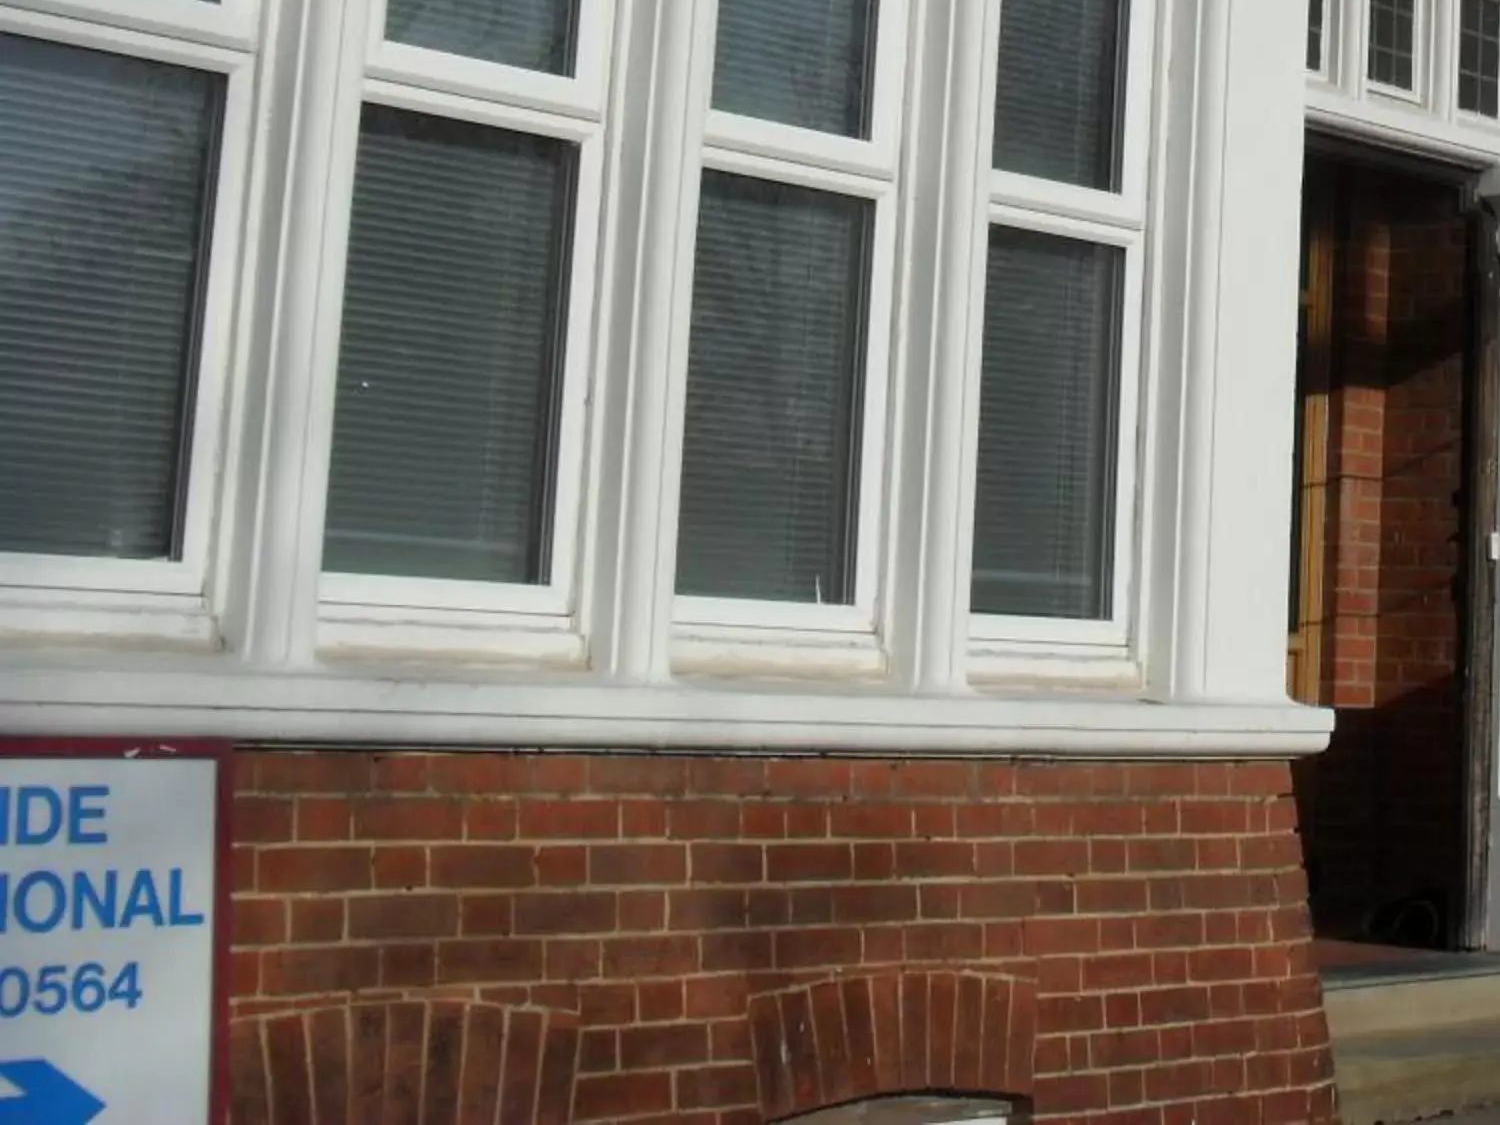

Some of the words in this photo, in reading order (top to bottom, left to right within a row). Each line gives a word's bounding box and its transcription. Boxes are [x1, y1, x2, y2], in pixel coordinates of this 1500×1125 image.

[0, 786, 109, 845] IDE
[0, 868, 204, 934] IONAL
[0, 961, 142, 1018] 0564
